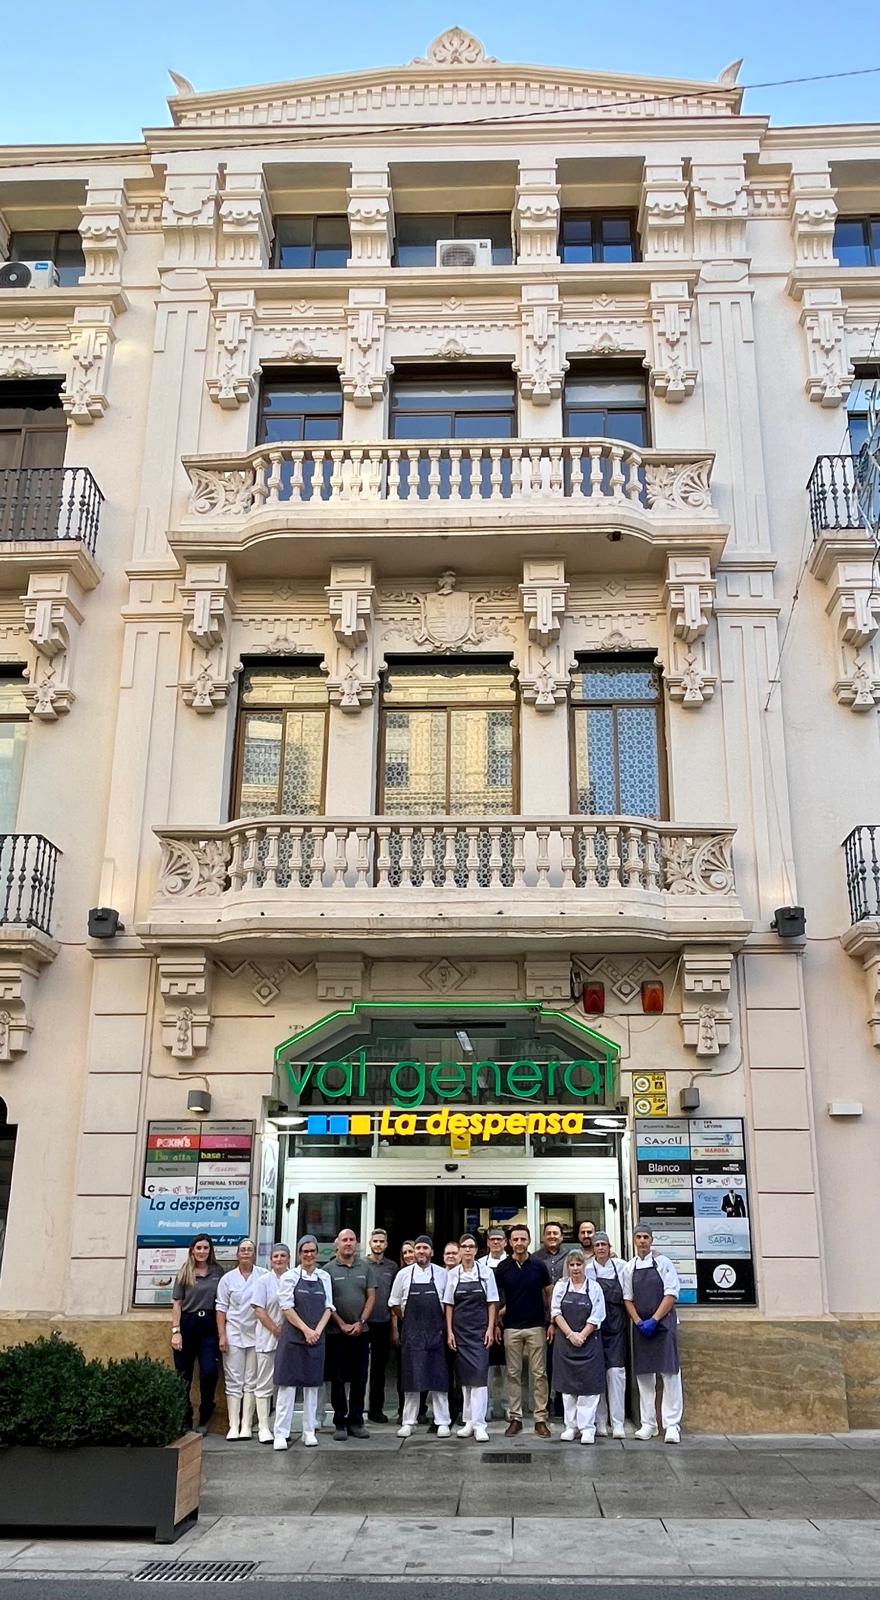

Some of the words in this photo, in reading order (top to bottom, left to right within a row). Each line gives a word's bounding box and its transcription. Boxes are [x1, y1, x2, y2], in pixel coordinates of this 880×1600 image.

[284, 1051, 366, 1098] val
[389, 1051, 615, 1109] general
[380, 1108, 417, 1136] La
[426, 1108, 584, 1142] despensa
[648, 1163, 680, 1172] Blanco
[149, 1199, 166, 1210] La
[170, 1198, 240, 1213] despensa
